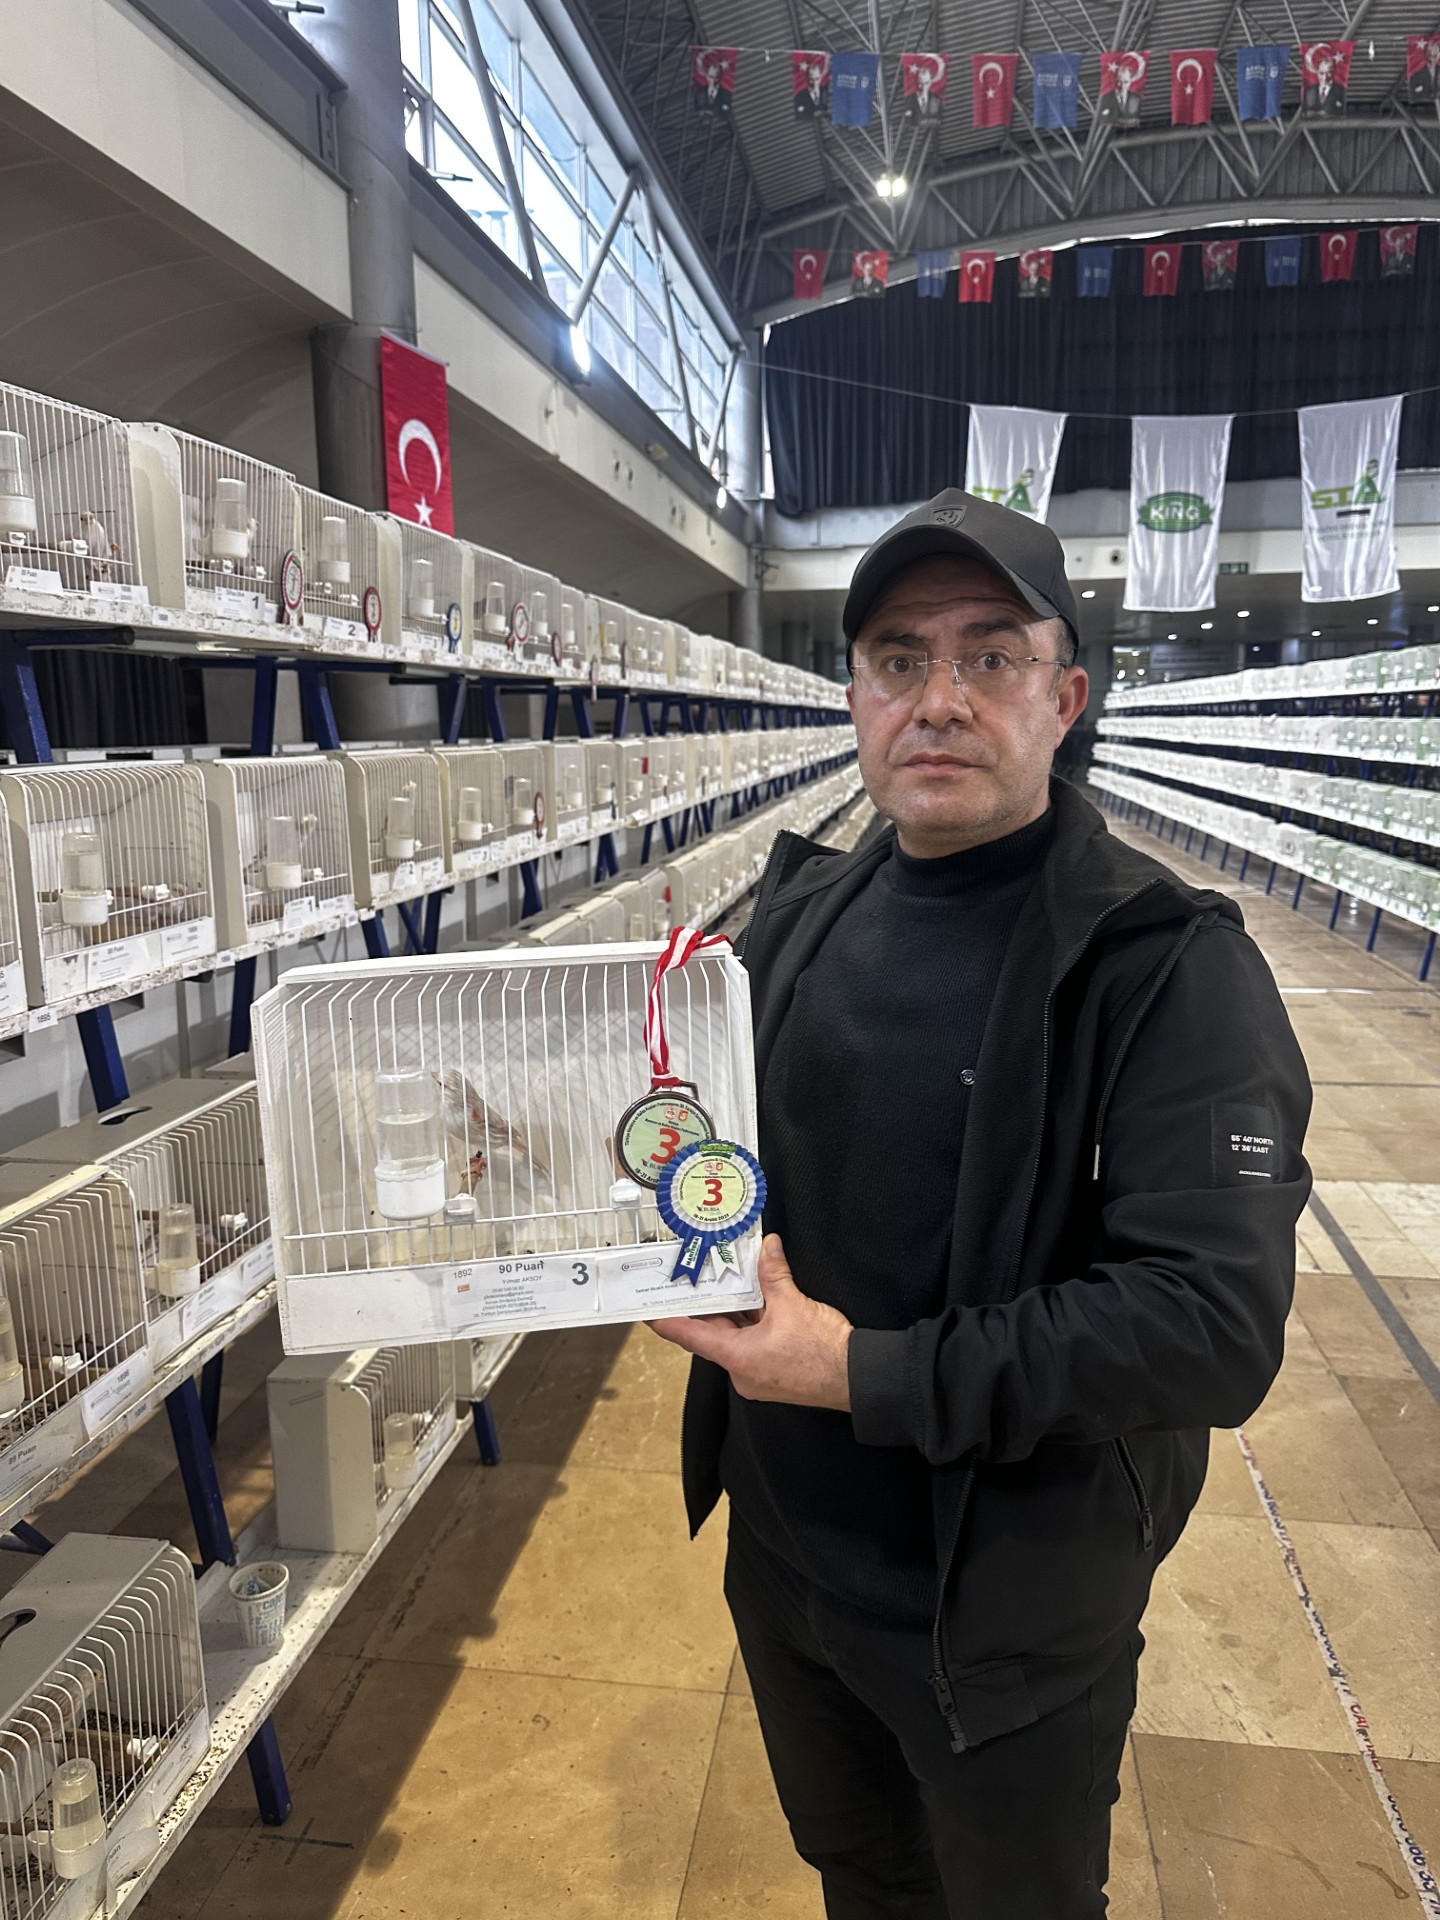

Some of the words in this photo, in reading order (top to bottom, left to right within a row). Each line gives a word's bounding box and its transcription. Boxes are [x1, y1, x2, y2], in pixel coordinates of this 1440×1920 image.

[1150, 505, 1200, 520] KING
[348, 624, 356, 636] 2
[650, 1127, 680, 1164] 3
[1253, 1137, 1274, 1146] NORTH
[1252, 1146, 1269, 1154] EAST
[703, 1178, 723, 1206] 3
[453, 1268, 473, 1279] 1892
[498, 1263, 513, 1274] 90
[516, 1261, 544, 1272] Puan
[522, 1275, 542, 1283] AKSOY
[571, 1262, 589, 1286] 3
